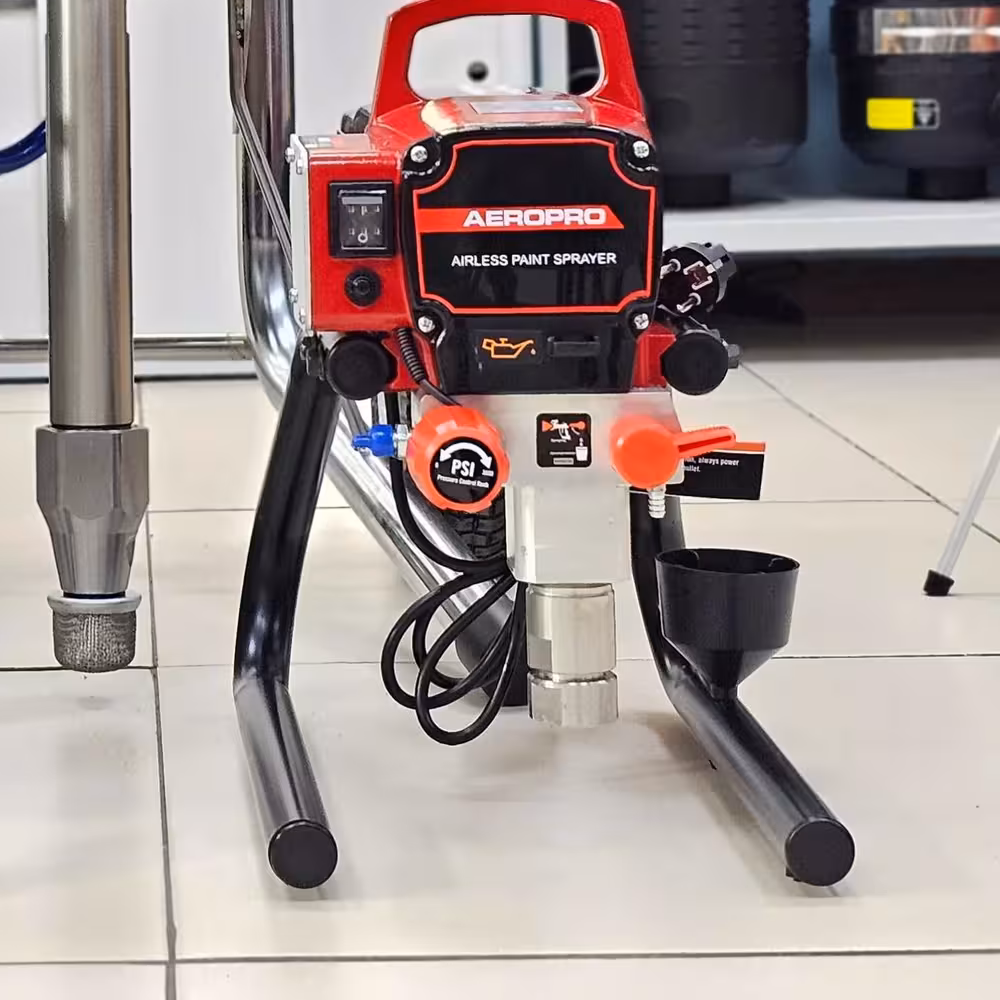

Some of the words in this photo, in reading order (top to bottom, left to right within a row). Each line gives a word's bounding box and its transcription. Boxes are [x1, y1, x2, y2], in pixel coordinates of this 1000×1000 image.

[463, 208, 607, 227] AEROPRO
[451, 255, 509, 267] AIRLESS
[511, 254, 550, 266] PAINT
[553, 253, 617, 265] SPRAYER
[451, 459, 476, 477] PSI
